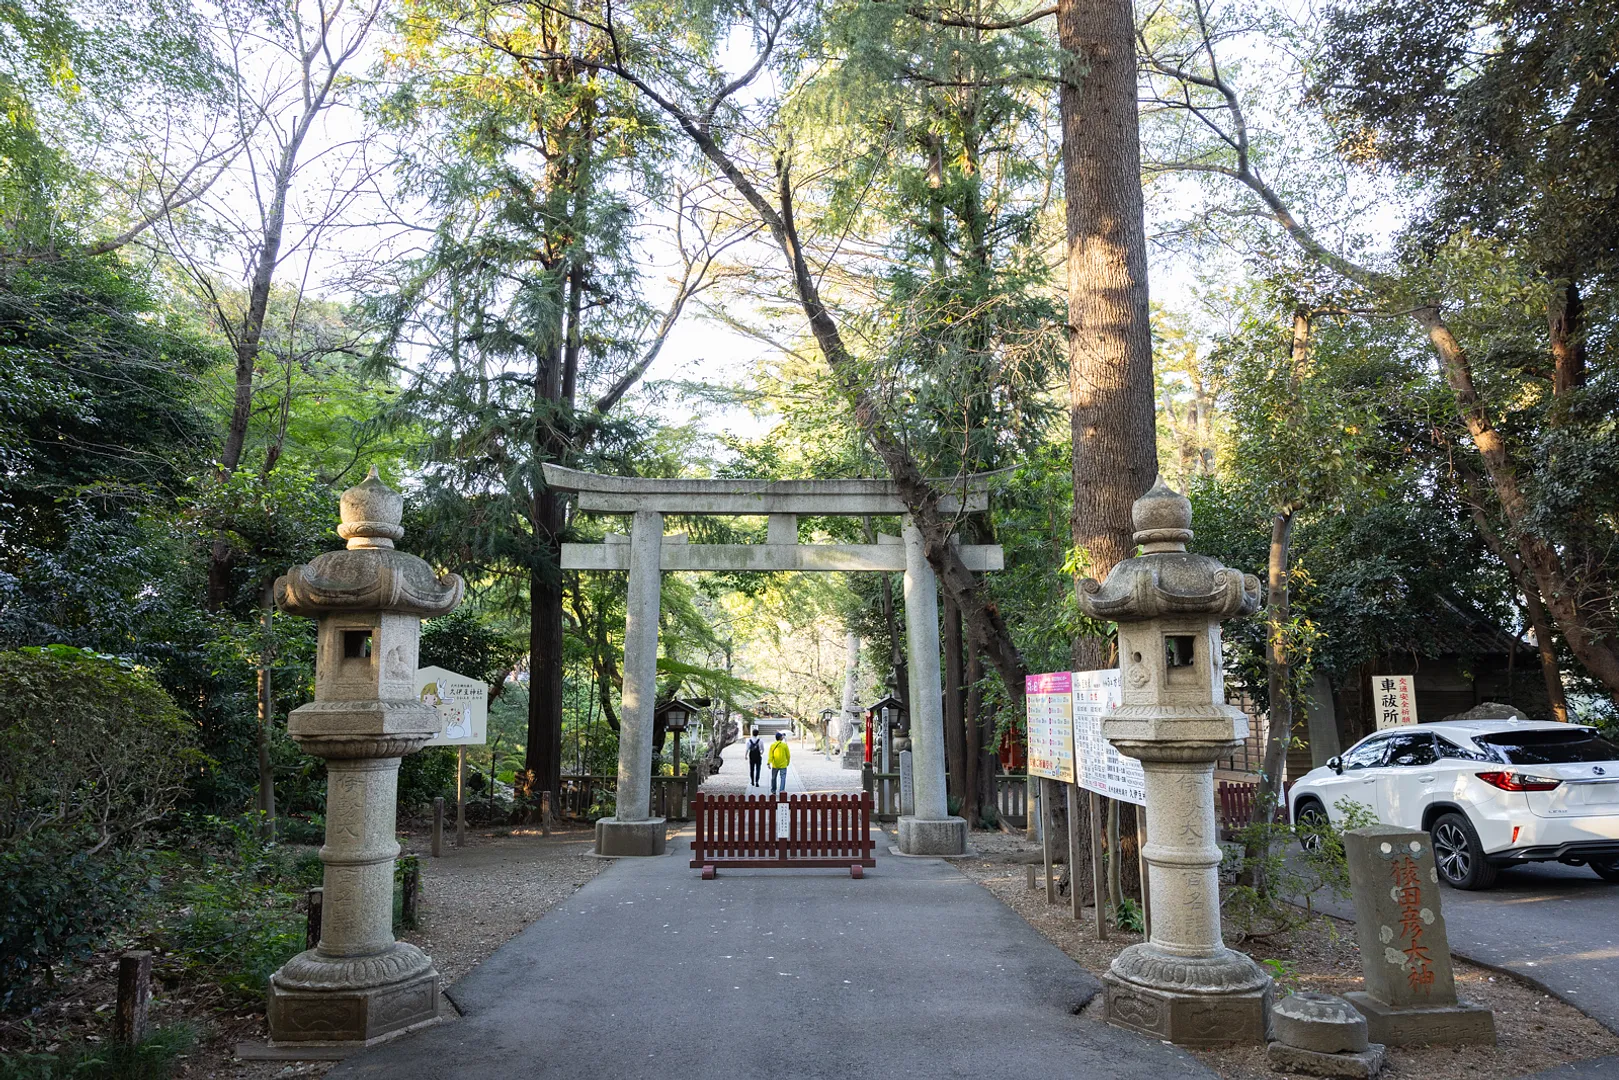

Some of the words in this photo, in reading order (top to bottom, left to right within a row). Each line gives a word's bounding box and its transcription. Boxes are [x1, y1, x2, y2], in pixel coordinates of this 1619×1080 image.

[449, 688, 483, 696] 久伊豆神社
[1380, 678, 1399, 724] 車祓所
[1399, 677, 1411, 723] 交通安全祈願
[1389, 856, 1436, 997] 猿田彦大神
